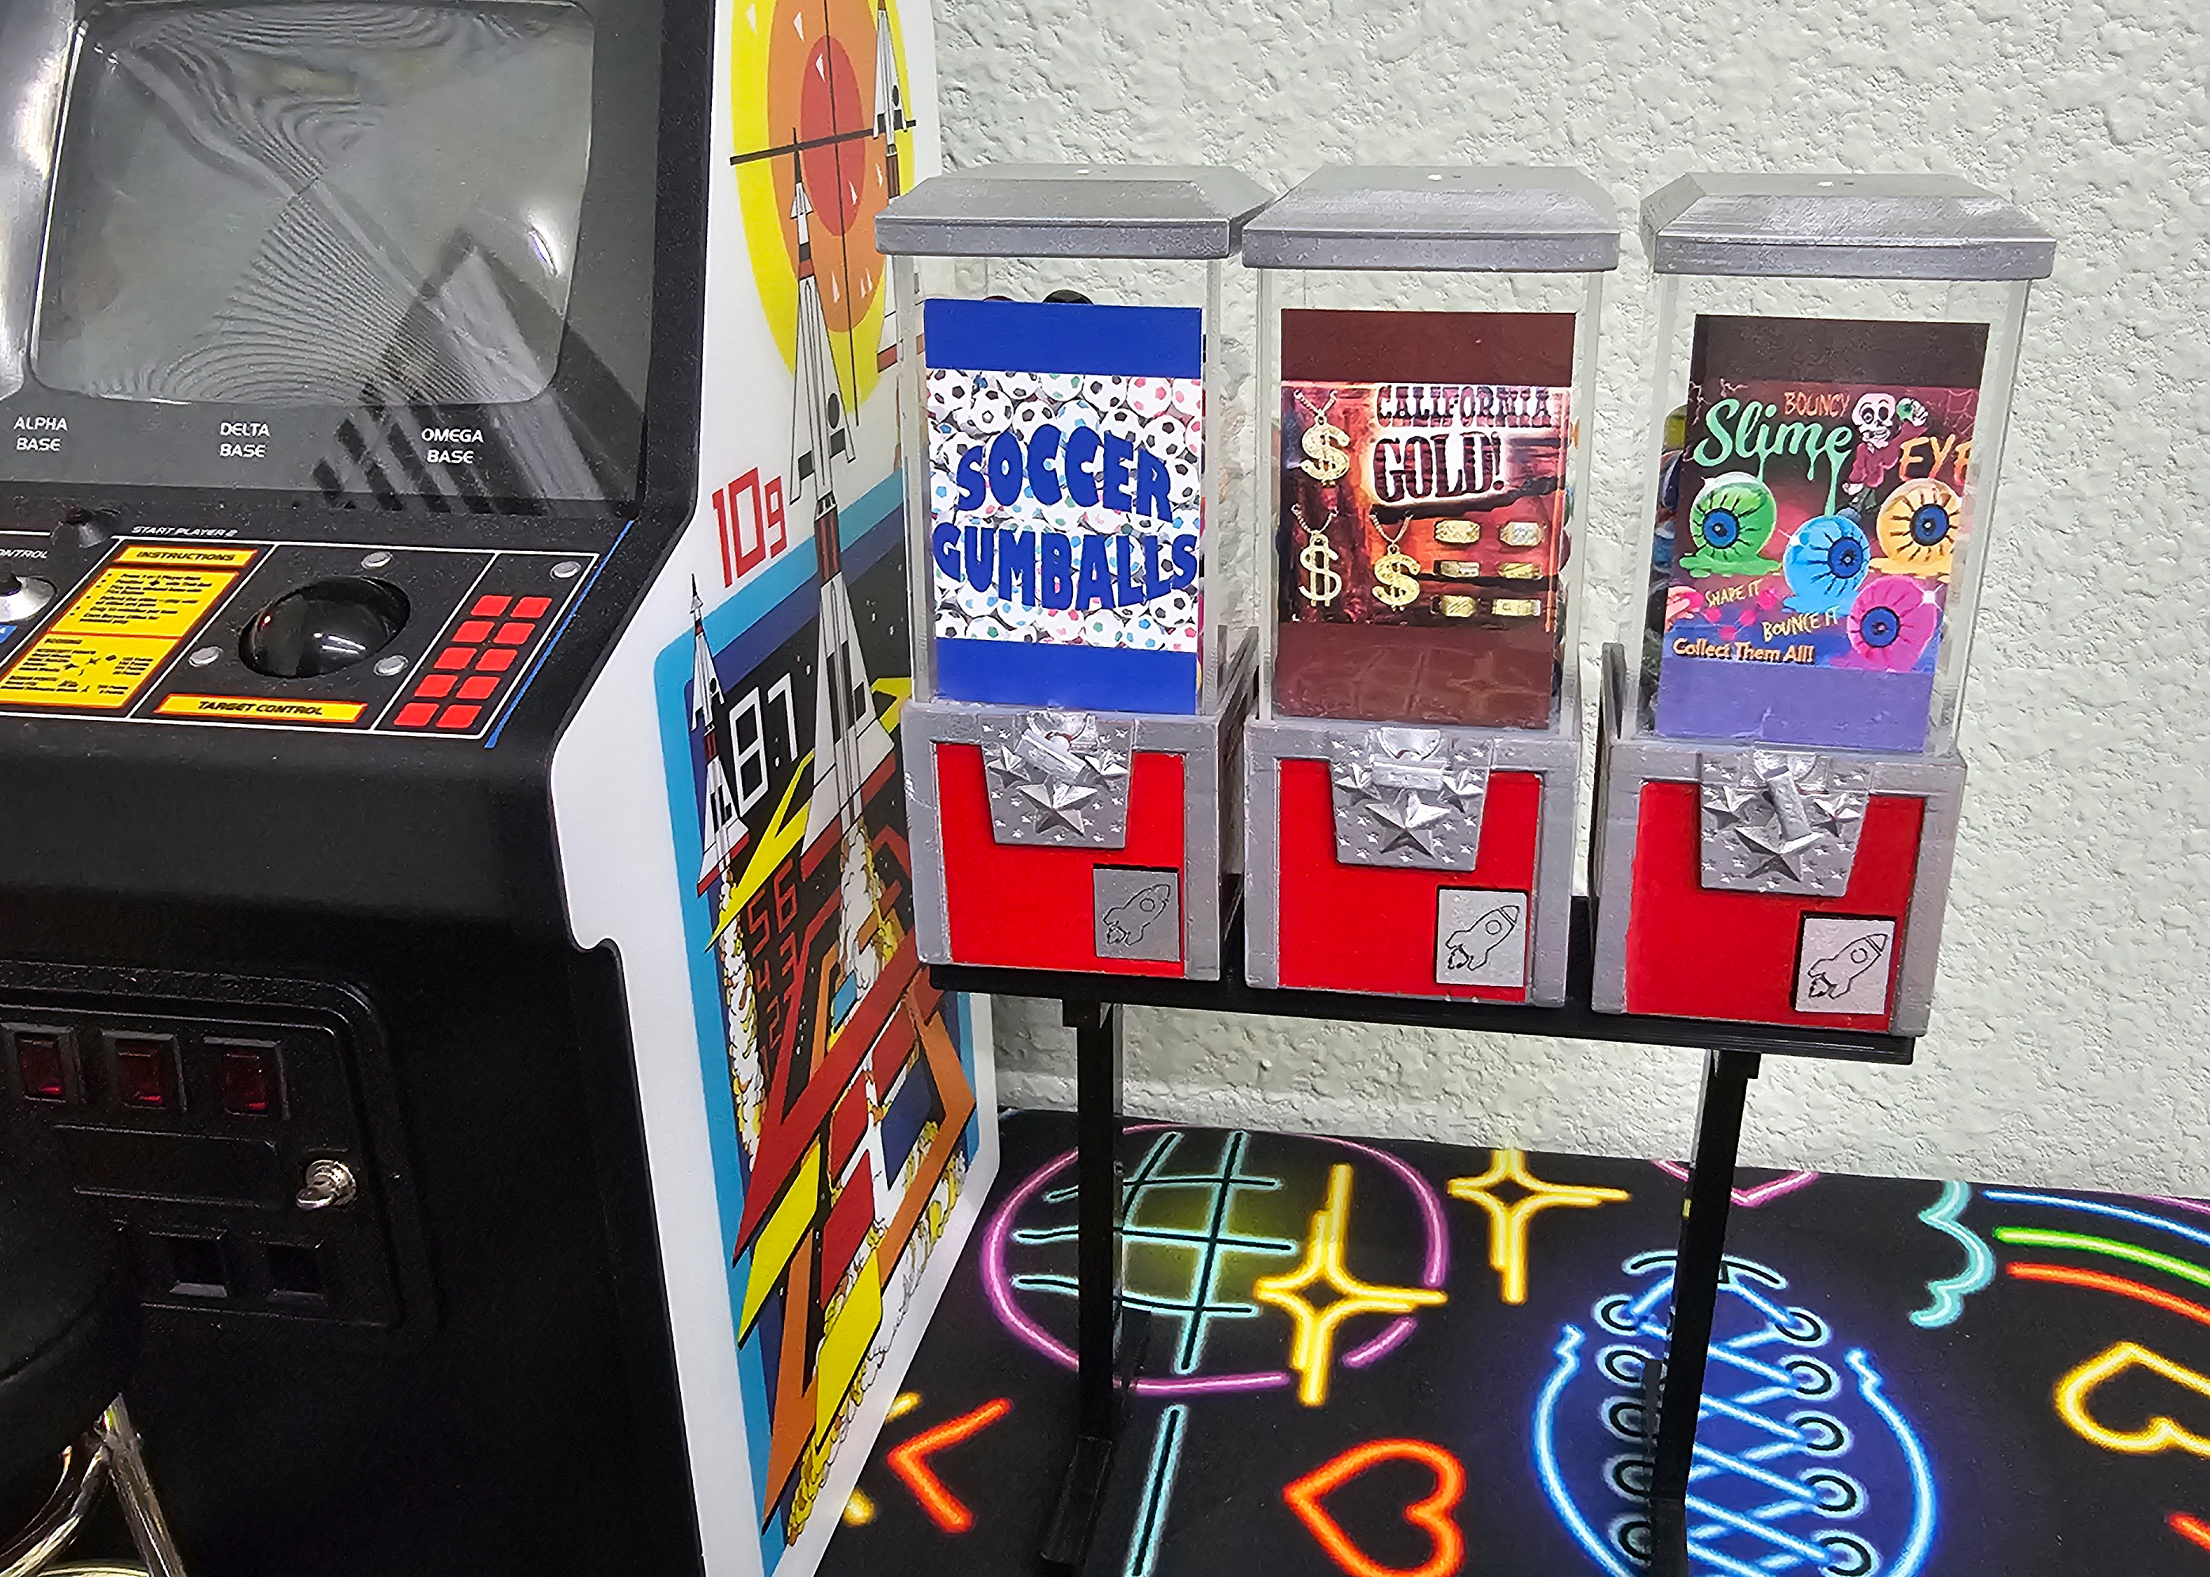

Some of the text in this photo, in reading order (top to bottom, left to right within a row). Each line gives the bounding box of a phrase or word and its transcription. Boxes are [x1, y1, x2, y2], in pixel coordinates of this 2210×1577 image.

[1376, 385, 1552, 427] CALIFORNIA
[1782, 390, 1850, 418] BOUNCY
[13, 415, 68, 432] ALPHA
[219, 421, 271, 438] DELTA
[15, 436, 62, 452] BASE
[420, 427, 485, 444] OMEGA
[1692, 397, 1853, 476] Slime
[219, 442, 267, 459] BASE
[426, 449, 475, 465] BASE
[956, 423, 1173, 523] SOCCER
[1372, 430, 1505, 503] GOLD!
[131, 525, 174, 536] START
[173, 527, 225, 538] PLAYER
[136, 550, 237, 562] INSTRUCTIONS
[932, 521, 1198, 611] GUMBALLS
[1705, 578, 1764, 608] SHAPE IT
[1761, 604, 1841, 643] BOUNCE IT
[1672, 637, 1731, 660] Collect
[1734, 640, 1781, 662] Them
[198, 700, 324, 716] TARGET CONTROL
